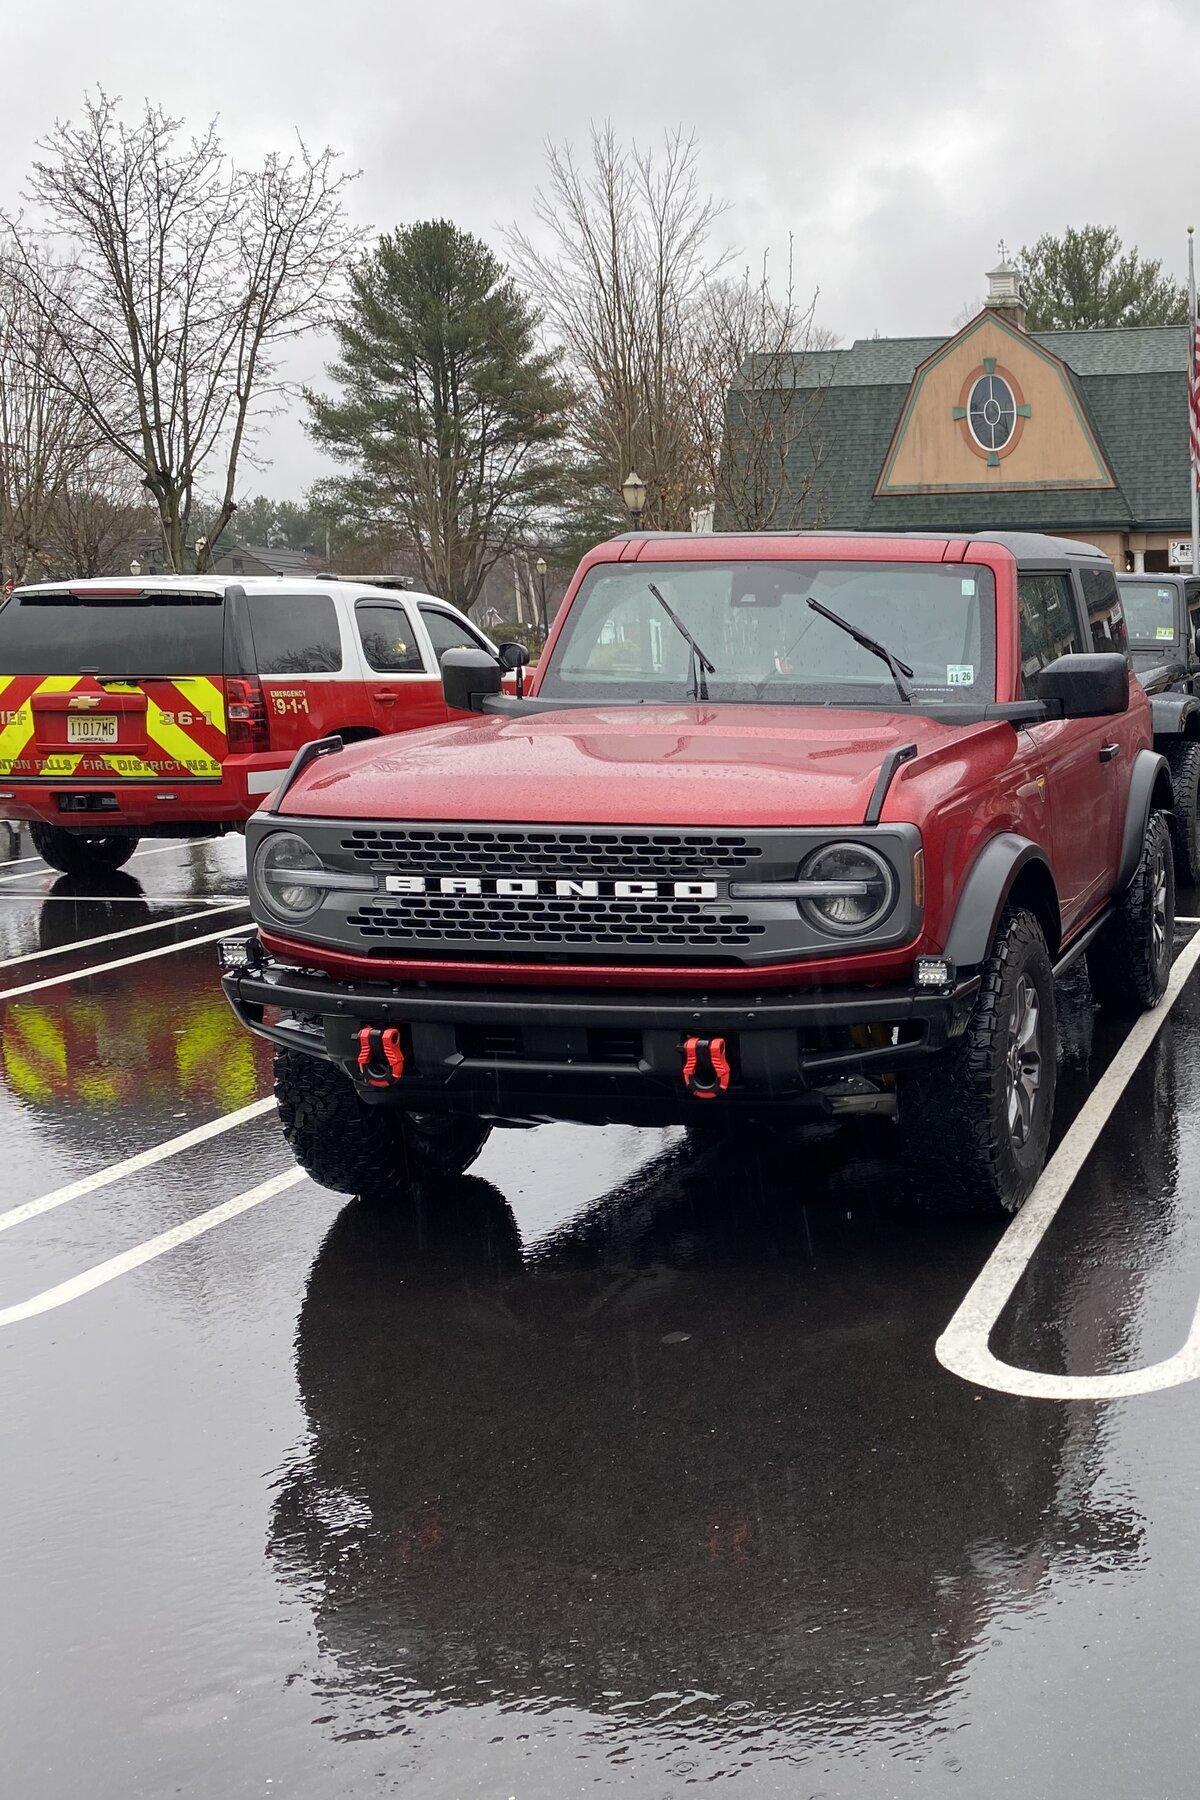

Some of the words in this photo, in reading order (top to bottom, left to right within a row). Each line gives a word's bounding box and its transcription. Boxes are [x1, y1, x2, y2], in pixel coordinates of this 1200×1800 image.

[159, 711, 212, 725] 36-1
[71, 722, 115, 736] 11017MG
[36, 759, 72, 770] FALLS
[83, 760, 112, 771] FIRE
[117, 760, 181, 771] DISTRICT
[385, 875, 718, 898] BRONCO
